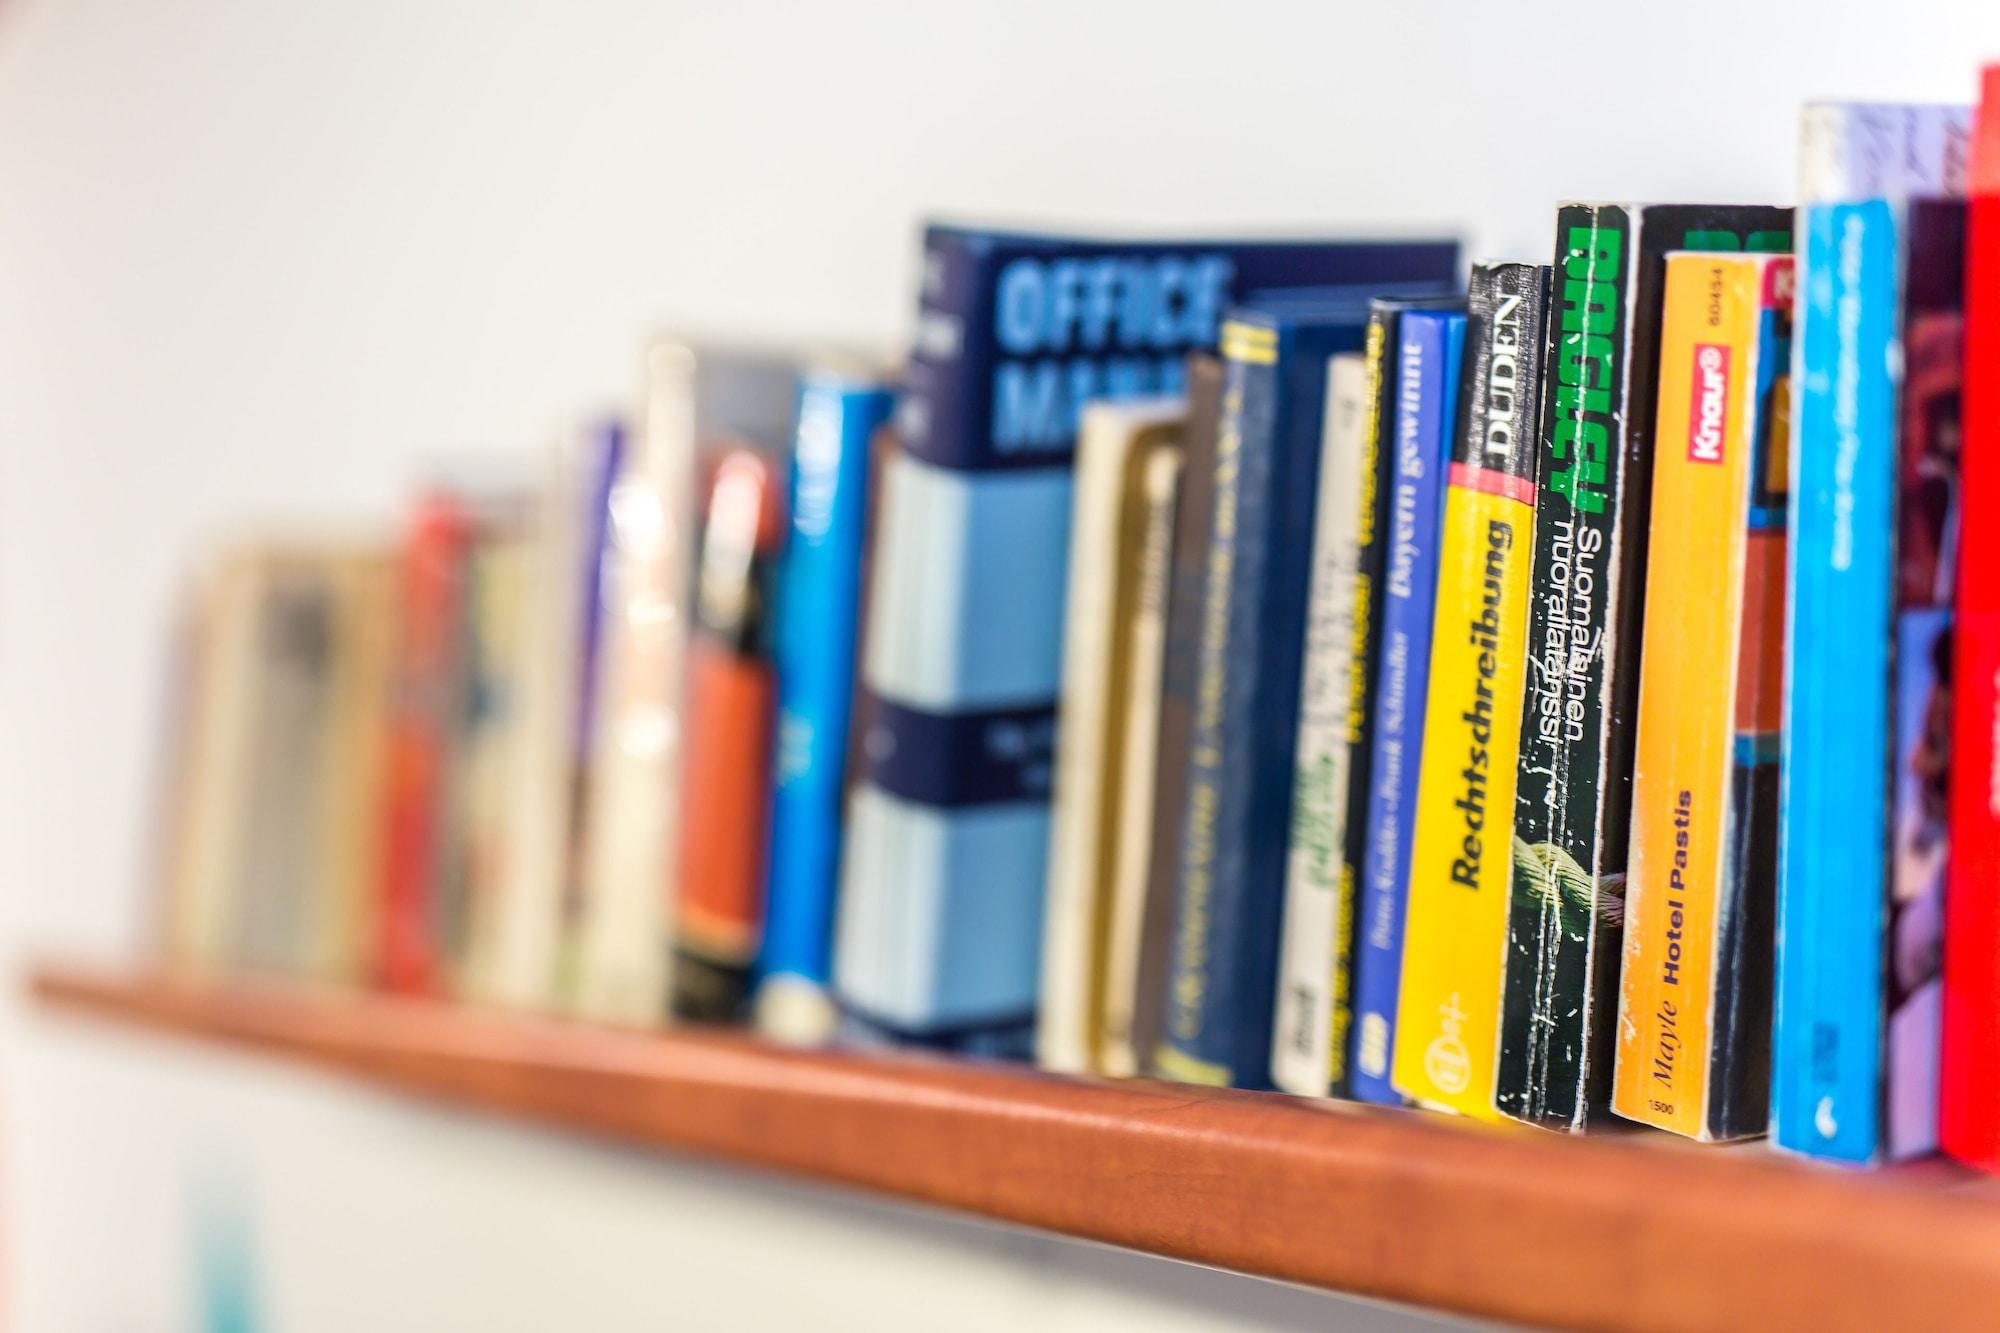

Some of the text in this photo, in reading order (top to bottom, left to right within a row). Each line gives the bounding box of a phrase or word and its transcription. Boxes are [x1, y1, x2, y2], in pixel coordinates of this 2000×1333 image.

[998, 257, 1232, 349] OFFICE
[1487, 292, 1522, 455] DUDEN
[1551, 226, 1622, 514] BAGLEY
[1399, 343, 1425, 479] gewinnt
[1387, 484, 1420, 598] Bayern
[1564, 526, 1602, 743] Suomalainen
[1451, 519, 1511, 890] Rechtschreibung
[1653, 791, 1692, 1090] Mayle Hotel Pastis
